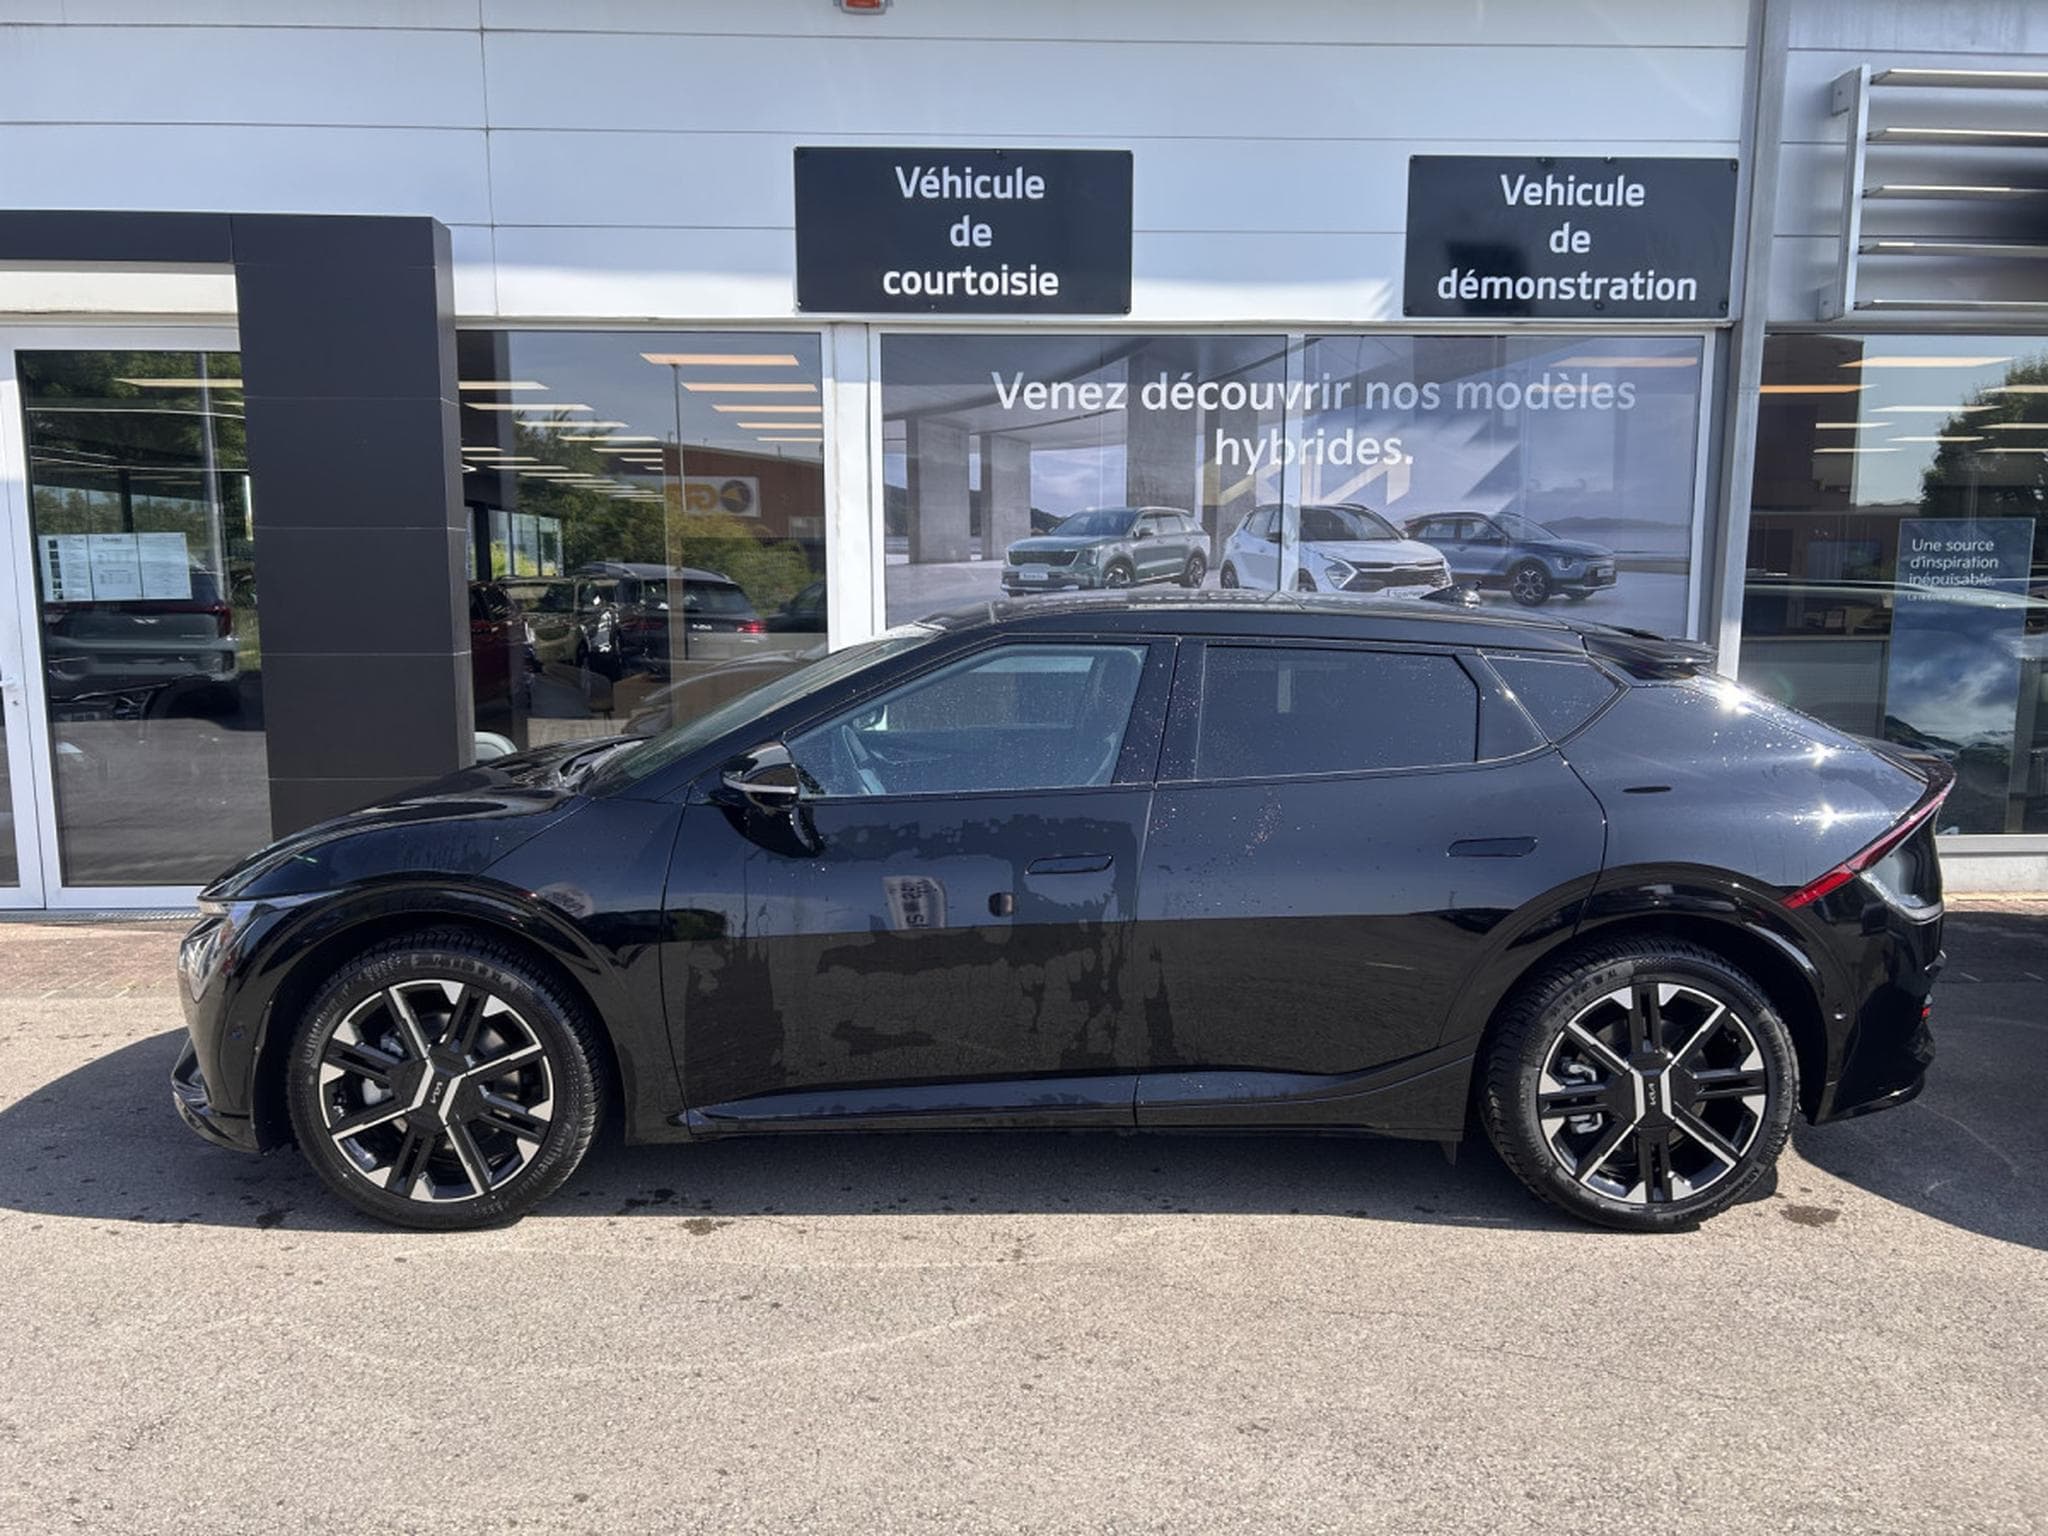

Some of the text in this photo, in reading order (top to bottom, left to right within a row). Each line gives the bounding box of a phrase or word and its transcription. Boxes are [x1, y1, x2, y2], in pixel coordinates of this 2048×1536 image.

[895, 166, 1046, 200] Véhicule
[1500, 174, 1646, 207] Vehicule
[950, 214, 993, 247] de
[1549, 221, 1592, 254] de
[883, 263, 1060, 297] courtoisie
[1437, 268, 1698, 302] démonstration
[991, 371, 1636, 411] Venez découvrir nos modèles
[1214, 428, 1414, 476] hybrides.
[1911, 538, 1995, 552] Une source
[1909, 556, 1999, 570] d'inspiration
